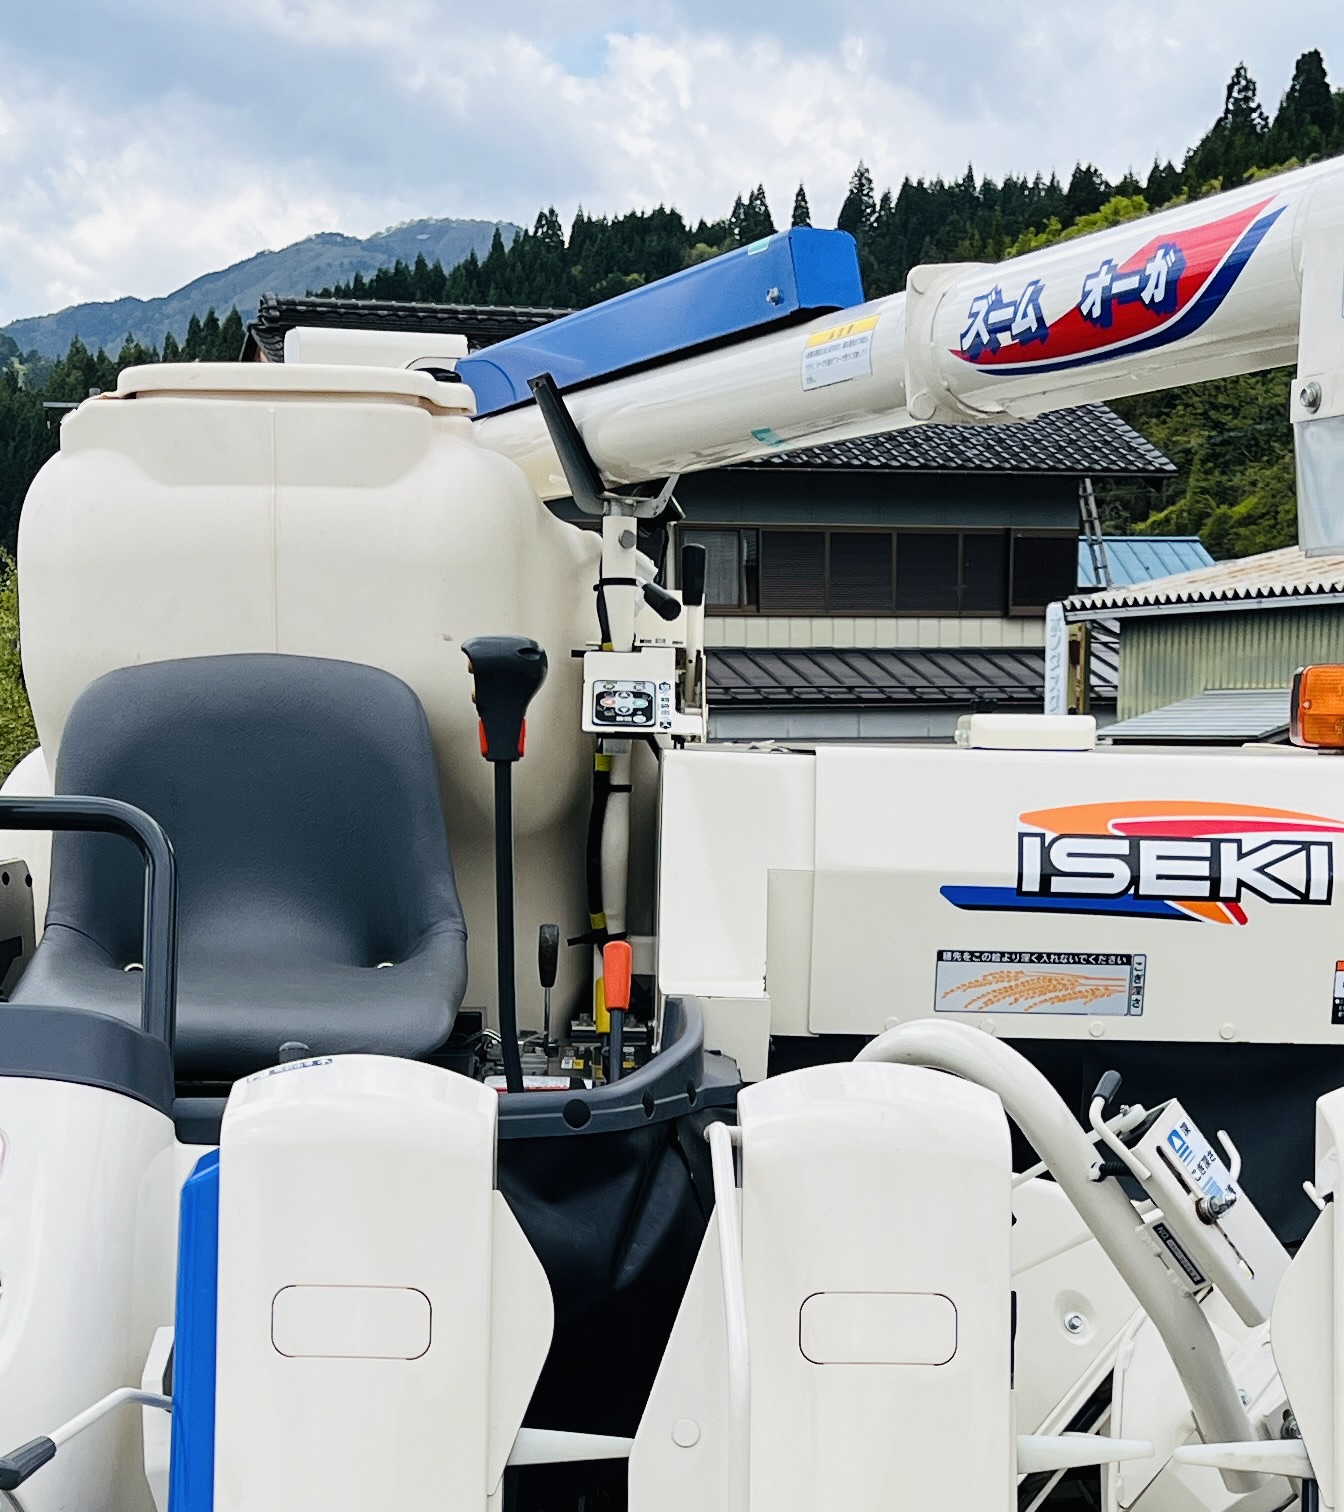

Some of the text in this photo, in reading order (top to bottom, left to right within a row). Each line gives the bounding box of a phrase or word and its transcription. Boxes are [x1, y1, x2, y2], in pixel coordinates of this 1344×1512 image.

[960, 248, 1177, 353] ズーム オーガ
[1018, 833, 1332, 904] ISEKI
